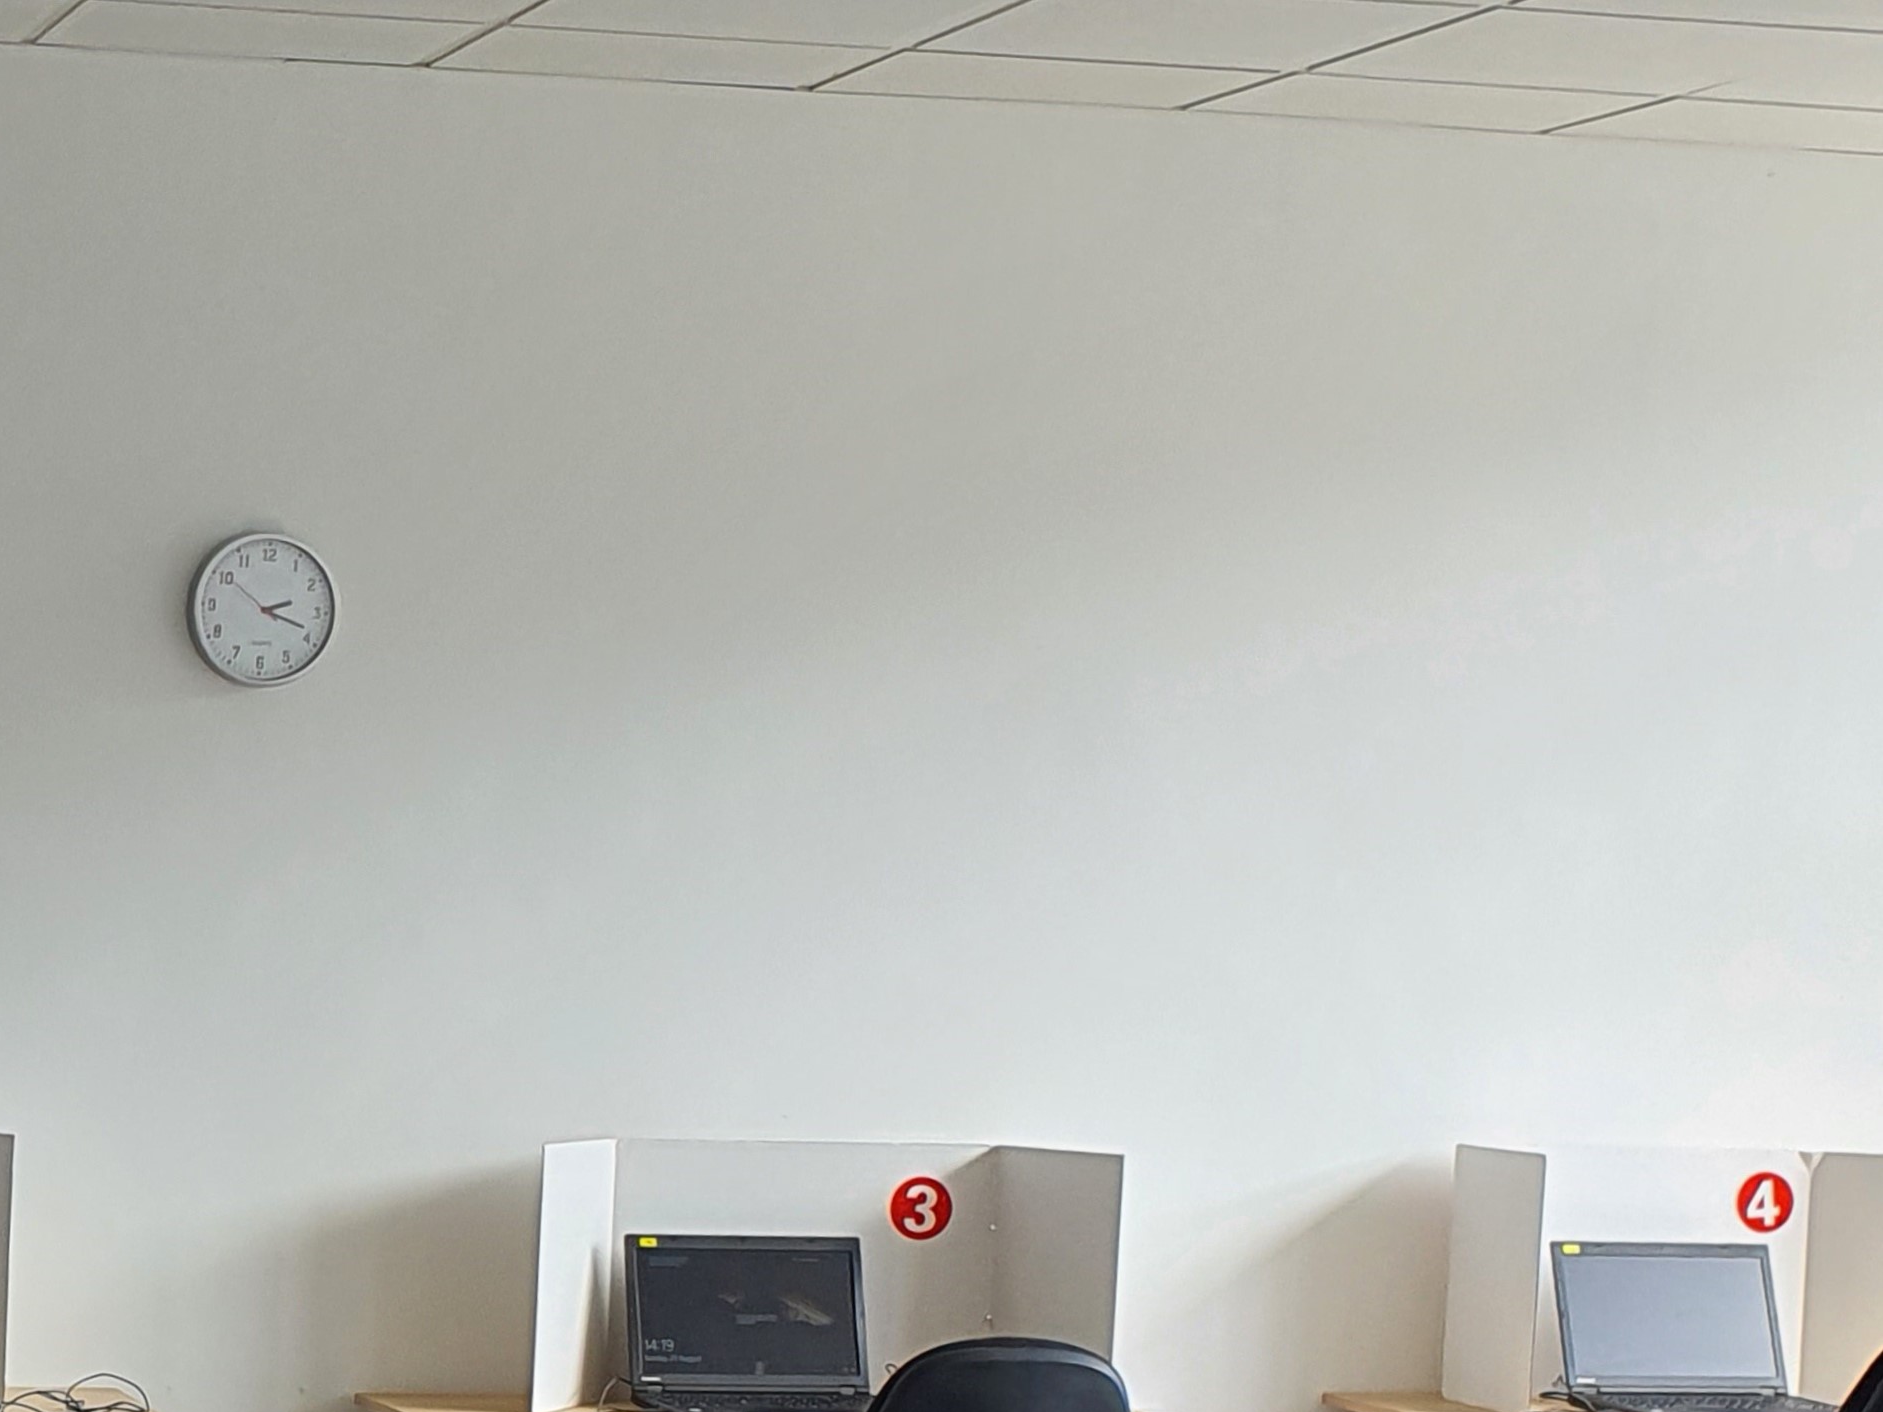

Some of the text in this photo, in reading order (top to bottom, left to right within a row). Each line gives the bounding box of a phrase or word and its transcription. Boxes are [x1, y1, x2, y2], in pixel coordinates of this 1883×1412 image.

[239, 554, 250, 568] 11
[262, 549, 277, 562] 12
[219, 571, 234, 585] 10
[307, 578, 316, 592] 2
[208, 598, 216, 611] 9
[313, 606, 321, 620] 3
[213, 624, 222, 638] 8
[303, 633, 311, 646] 4
[232, 645, 241, 659] 7
[282, 650, 290, 663] 5
[256, 656, 264, 670] 6
[903, 1184, 938, 1233] 3
[1746, 1178, 1781, 1227] 4
[644, 1338, 675, 1353] 14:19
